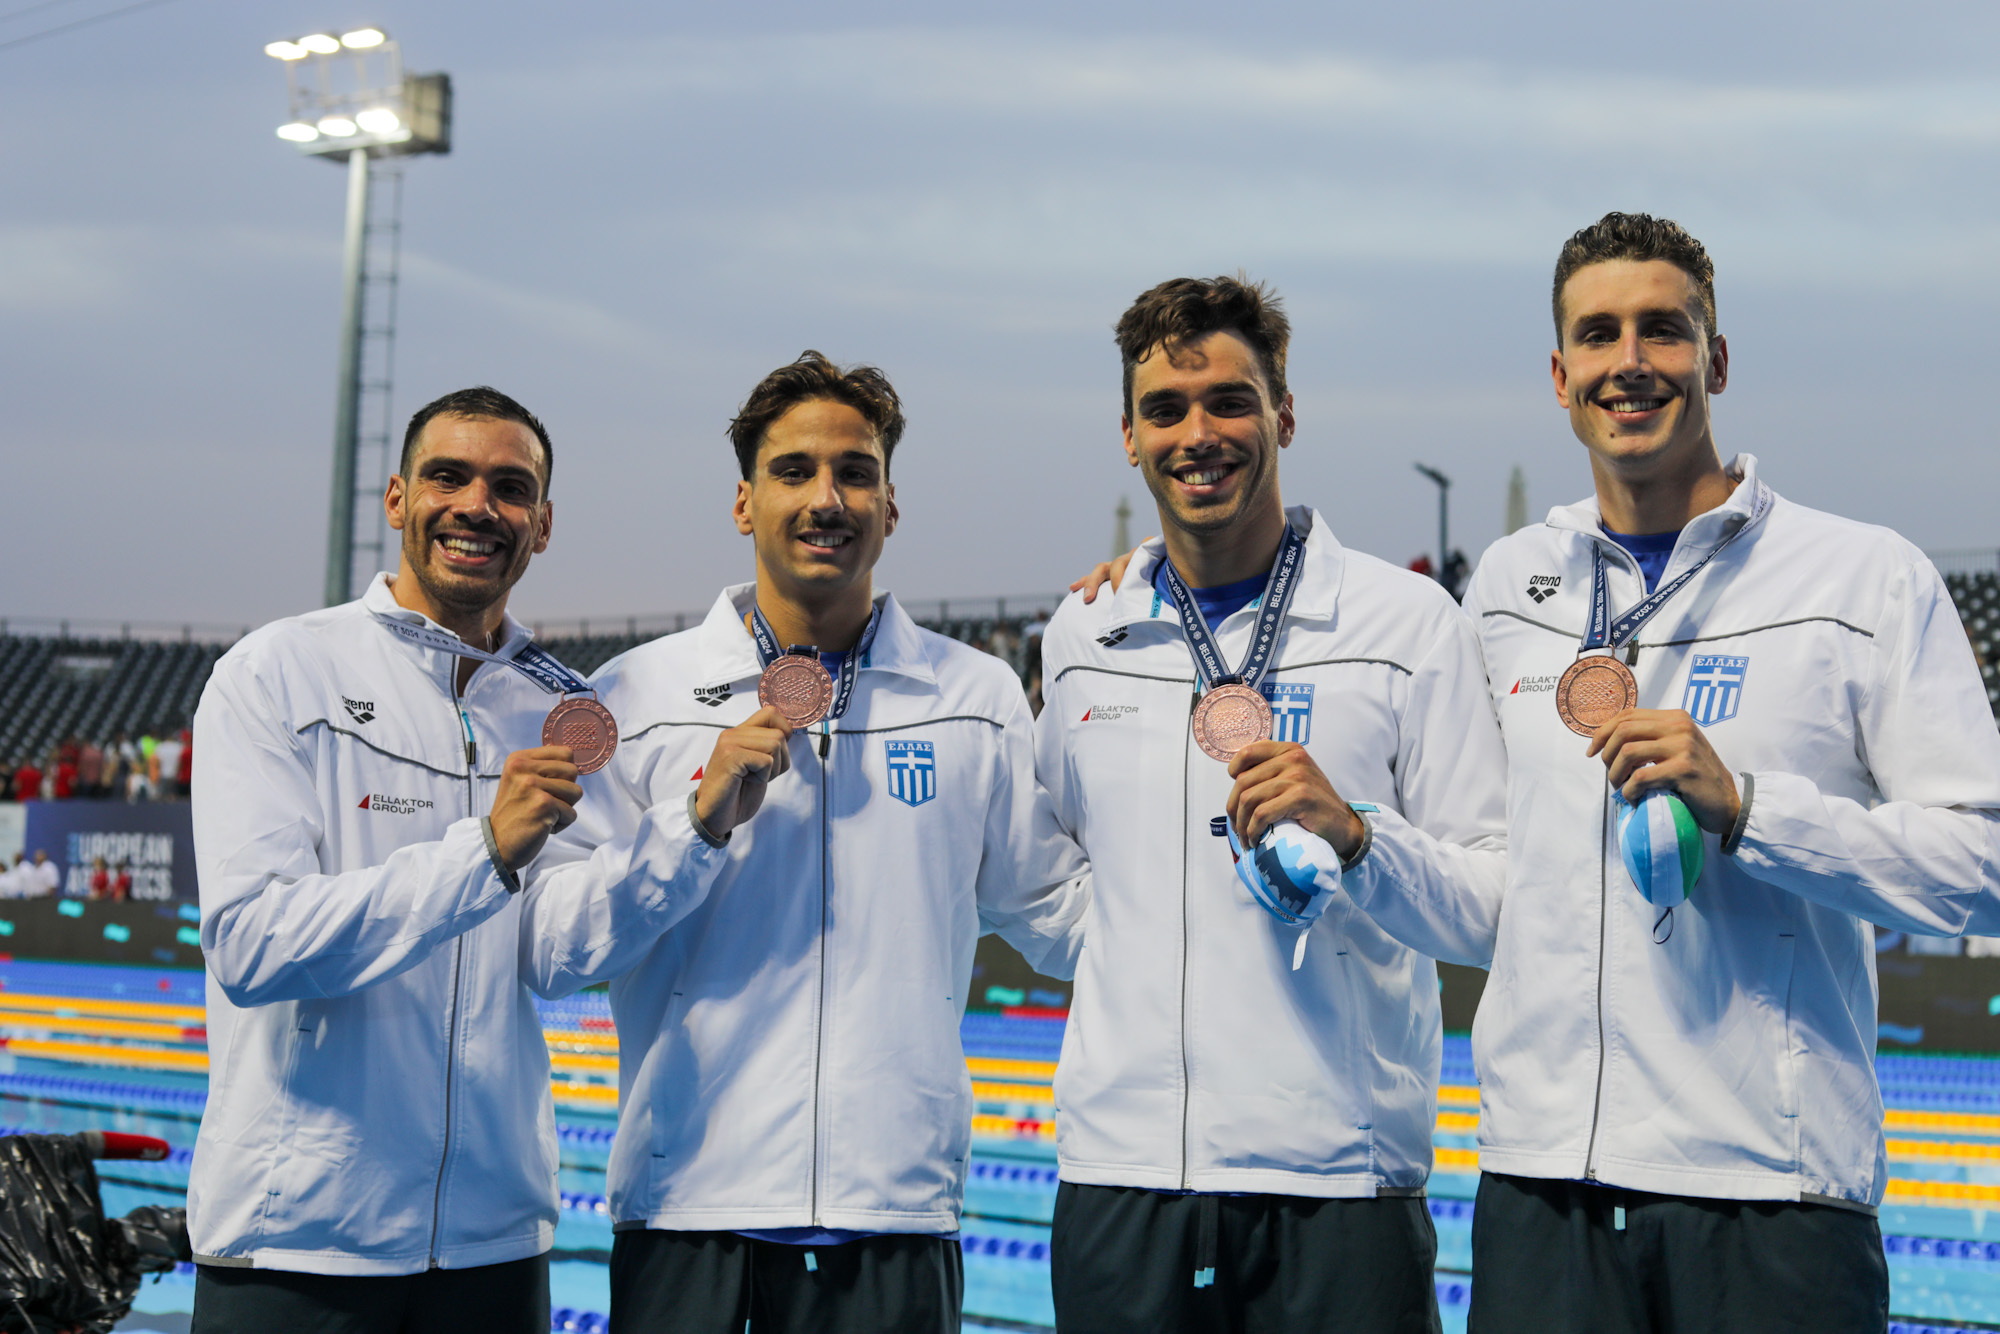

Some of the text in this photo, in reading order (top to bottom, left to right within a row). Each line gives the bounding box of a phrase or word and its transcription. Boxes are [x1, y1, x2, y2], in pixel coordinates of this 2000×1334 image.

[1270, 545, 1297, 608] BELGRADE 2024
[1529, 575, 1562, 587] arena
[1173, 583, 1185, 602] 2024
[1631, 604, 1654, 621] 2024
[759, 635, 773, 654] 2024
[1521, 676, 1560, 685] ELLAKT
[1519, 684, 1555, 693] GROUP
[341, 695, 375, 711] arena
[1092, 705, 1139, 713] ELLAKTOR
[1090, 713, 1121, 721] GROUP
[373, 793, 434, 809] ELLAKTOR
[371, 803, 416, 815] GROUP
